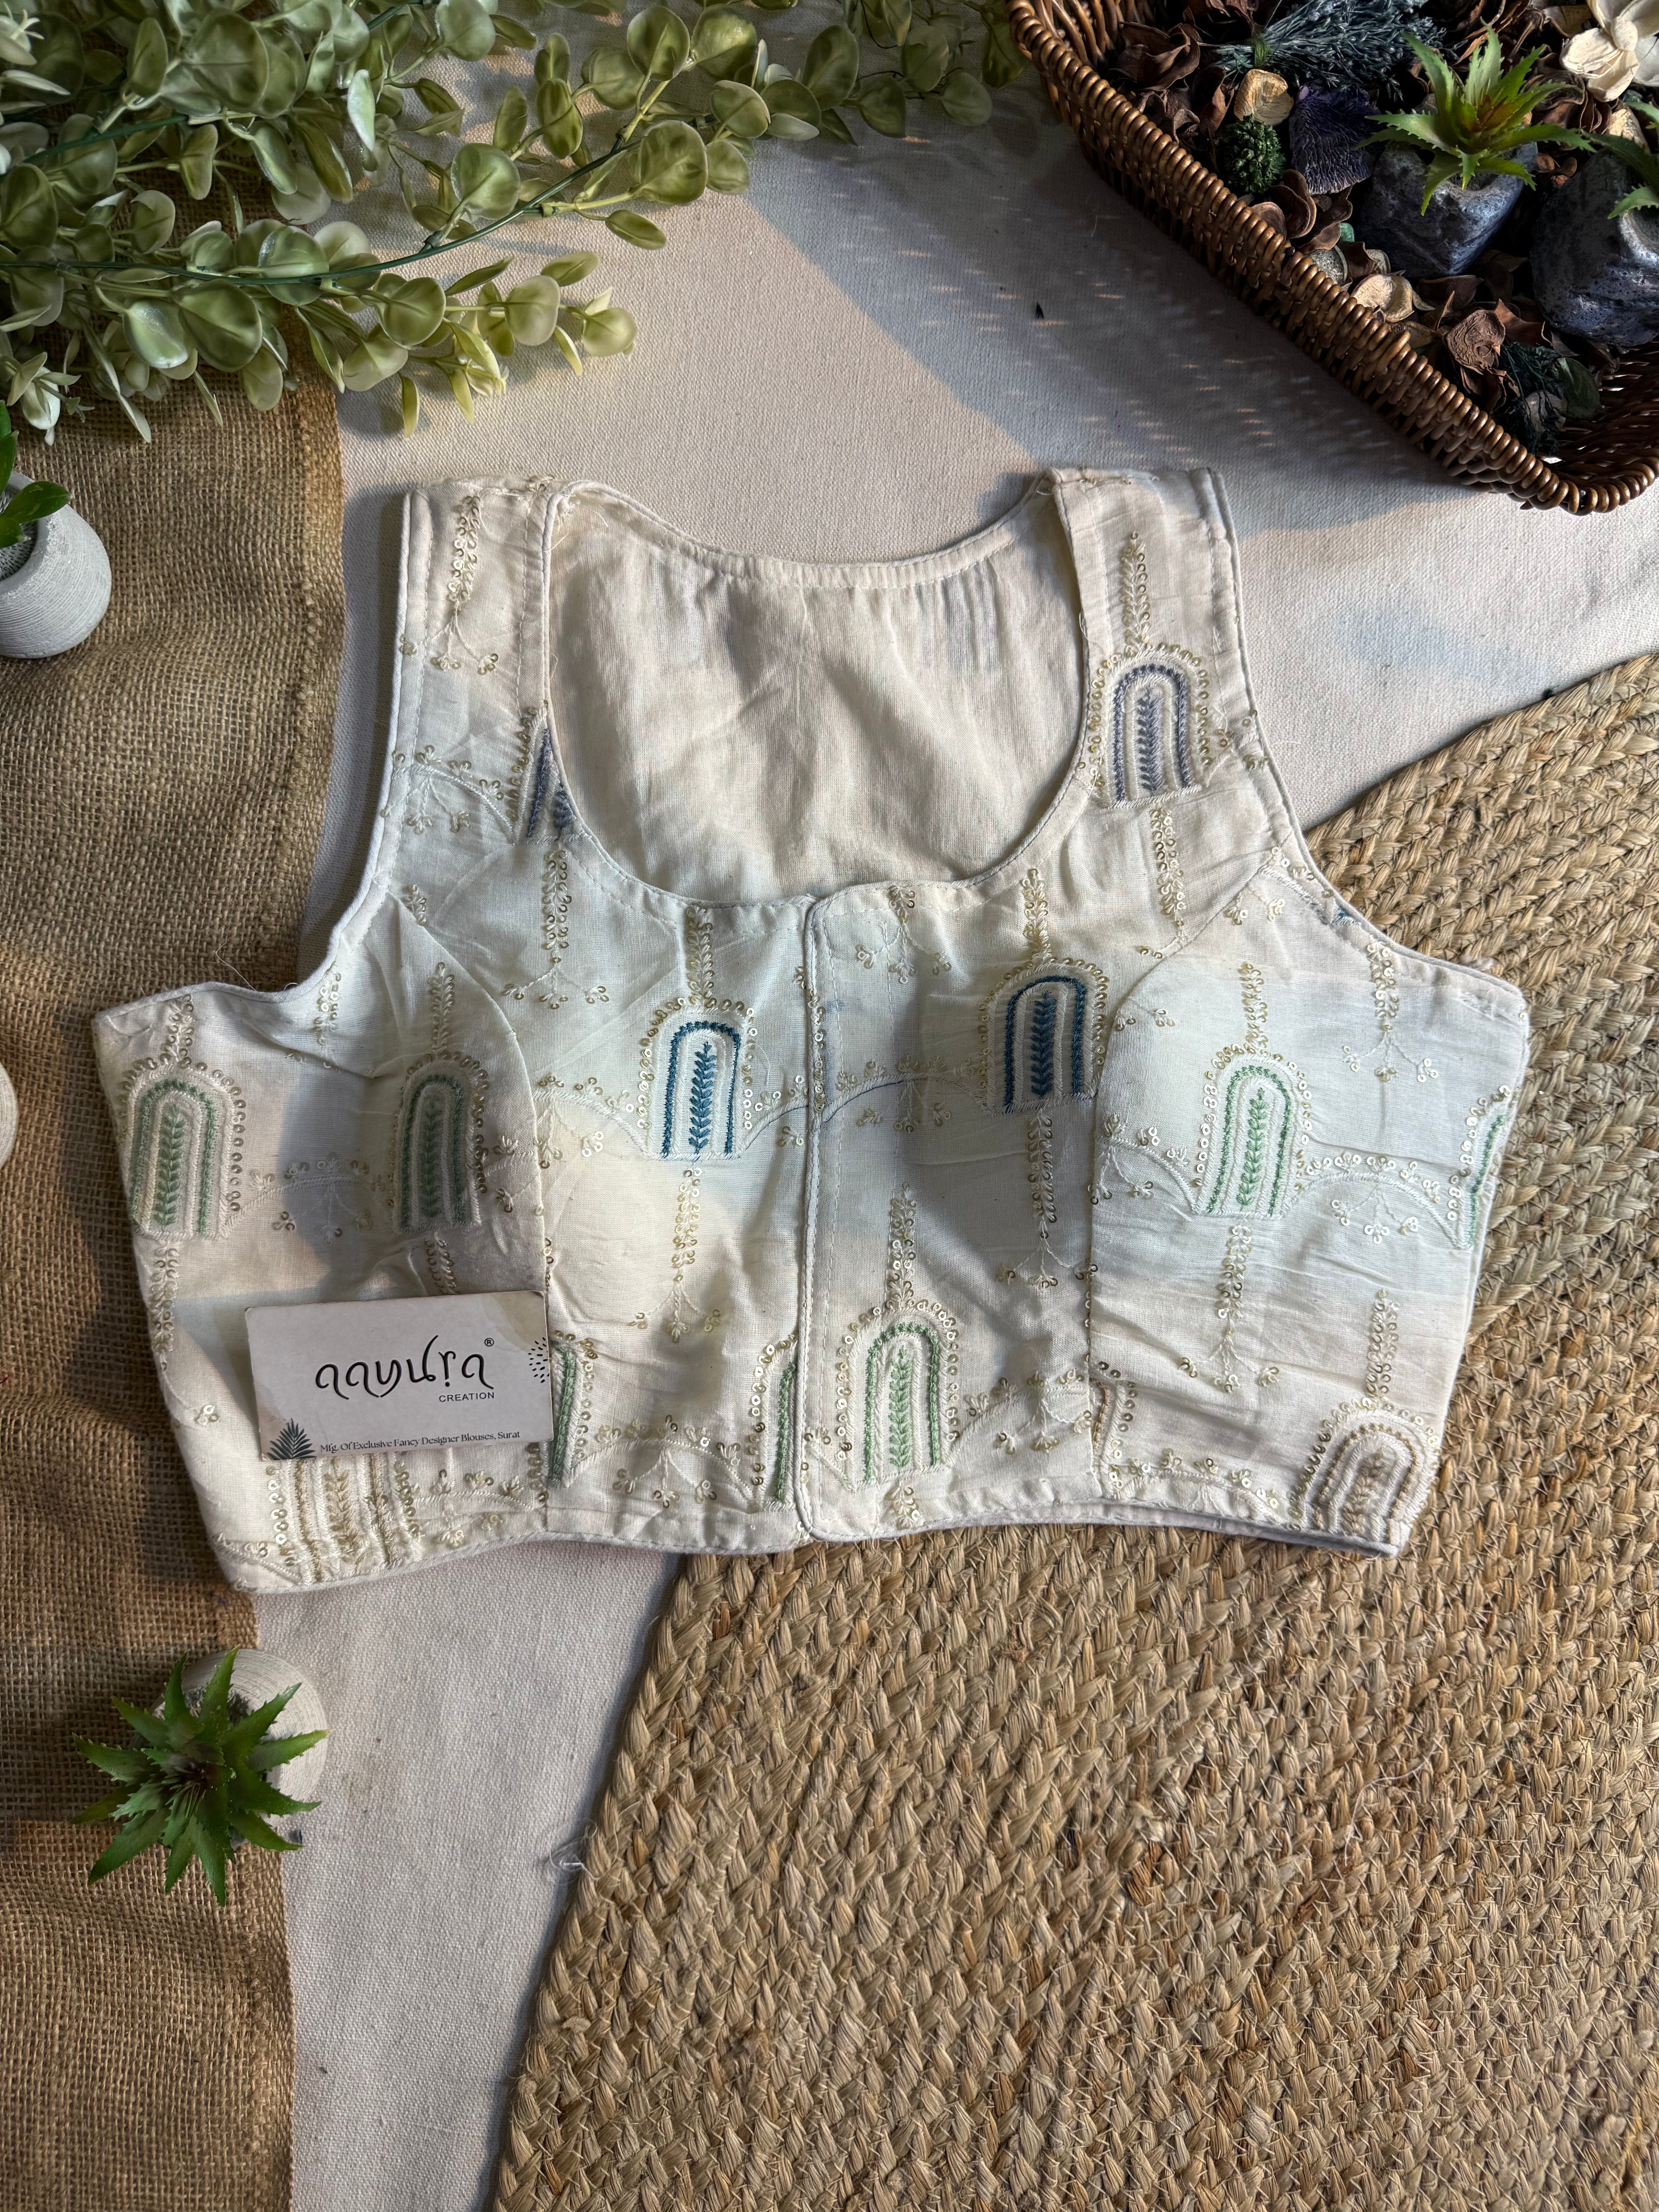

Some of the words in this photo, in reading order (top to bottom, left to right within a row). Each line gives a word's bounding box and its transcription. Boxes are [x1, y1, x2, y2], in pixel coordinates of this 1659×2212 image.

[439, 1391, 495, 1403] CREATION
[321, 1444, 339, 1453] Mfg.
[341, 1442, 352, 1451] Of
[353, 1440, 393, 1450] Exclusive
[394, 1438, 420, 1447] Fancy
[422, 1436, 460, 1445] Designer
[461, 1433, 496, 1442] Blouses,
[498, 1431, 520, 1439] Surat
